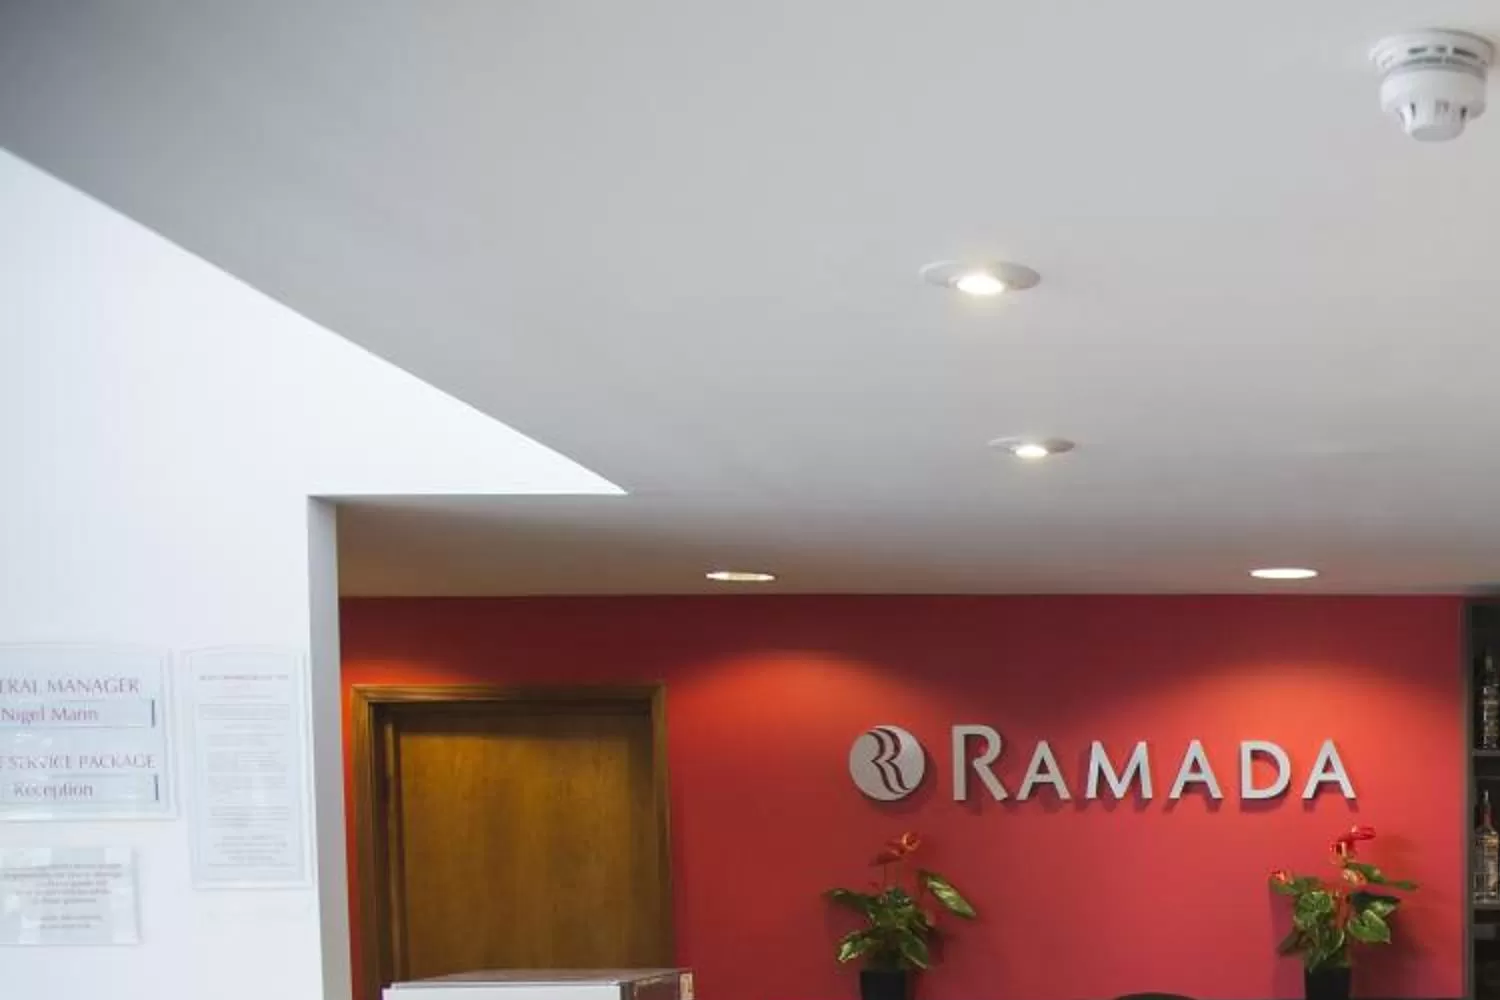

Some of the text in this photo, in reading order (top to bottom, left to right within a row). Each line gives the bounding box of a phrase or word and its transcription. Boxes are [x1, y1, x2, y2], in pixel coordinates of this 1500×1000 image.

[47, 677, 141, 694] MANAGER
[1, 704, 45, 725] Nigel
[8, 754, 72, 769] SERVICE
[79, 753, 156, 769] PACKAGE
[952, 724, 1357, 801] RAMADA
[13, 782, 93, 800] Reception
